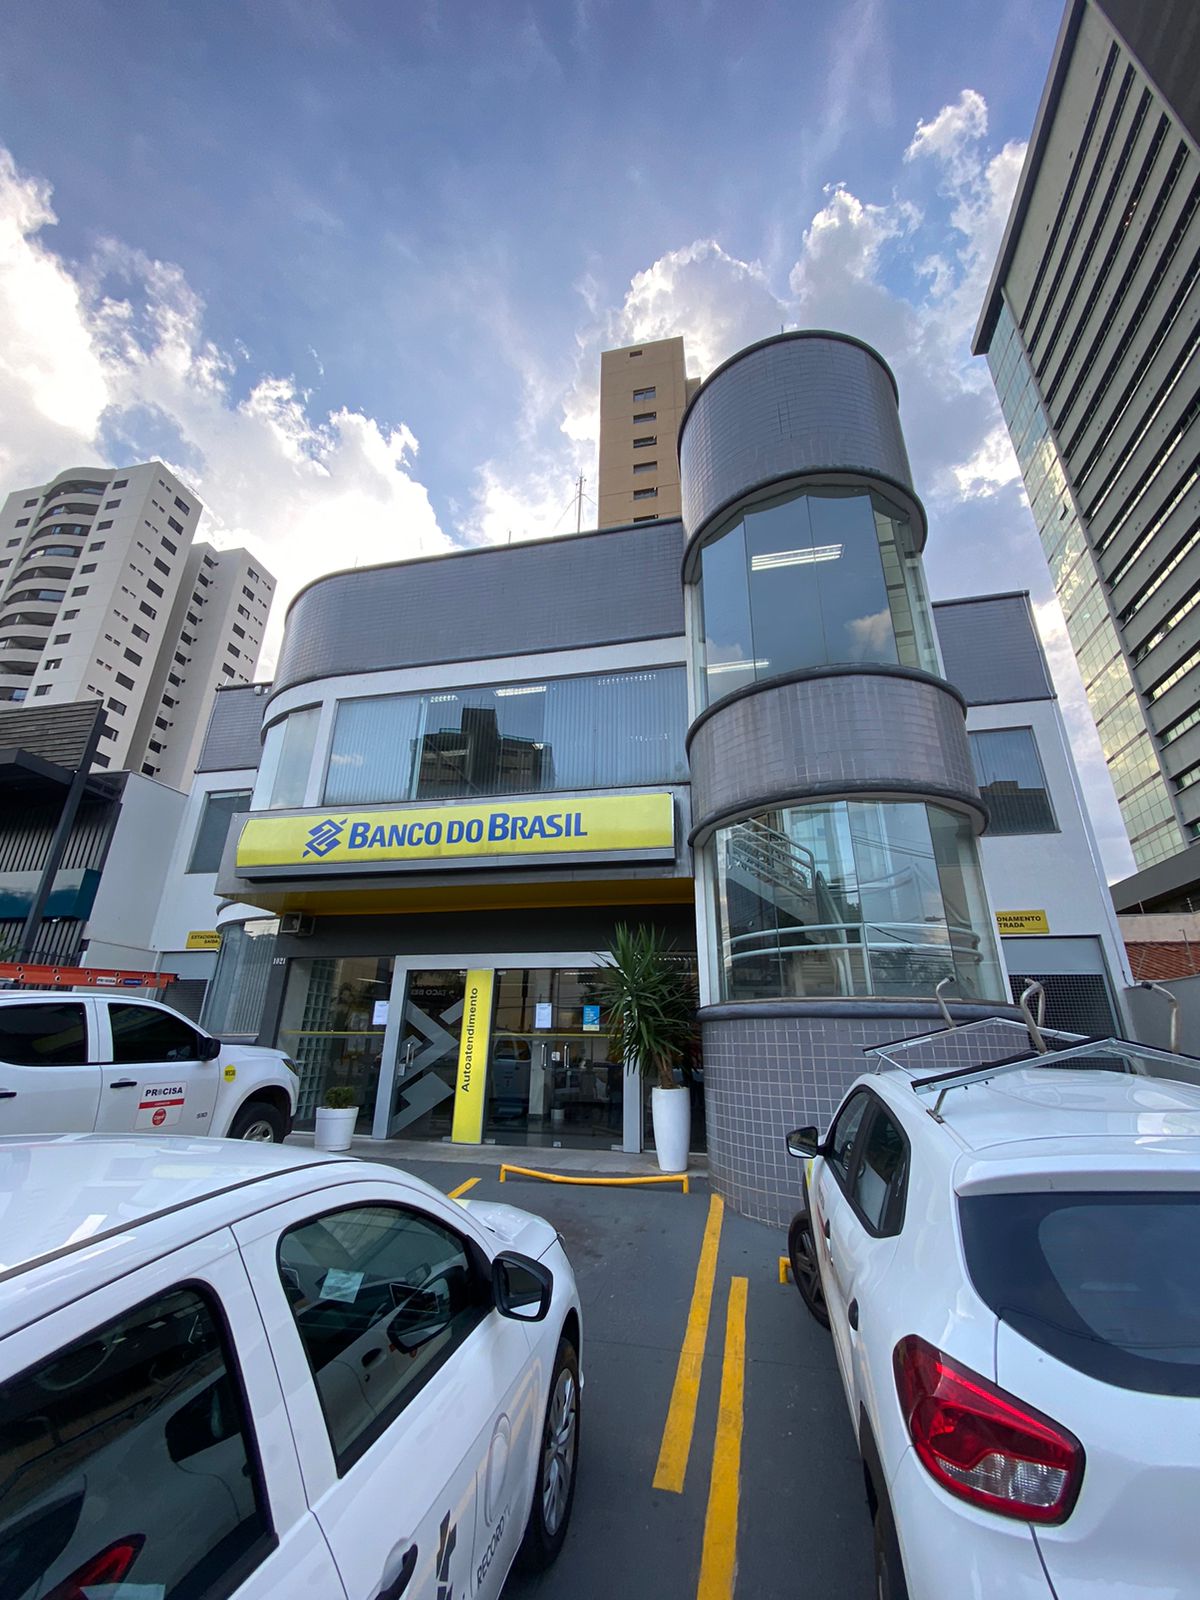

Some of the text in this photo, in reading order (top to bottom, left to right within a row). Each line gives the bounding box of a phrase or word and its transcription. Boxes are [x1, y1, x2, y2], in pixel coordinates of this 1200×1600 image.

[348, 812, 588, 849] BANCO DO BRASIL
[461, 987, 478, 1093] Autoatendimento
[477, 1515, 505, 1589] RECORD
